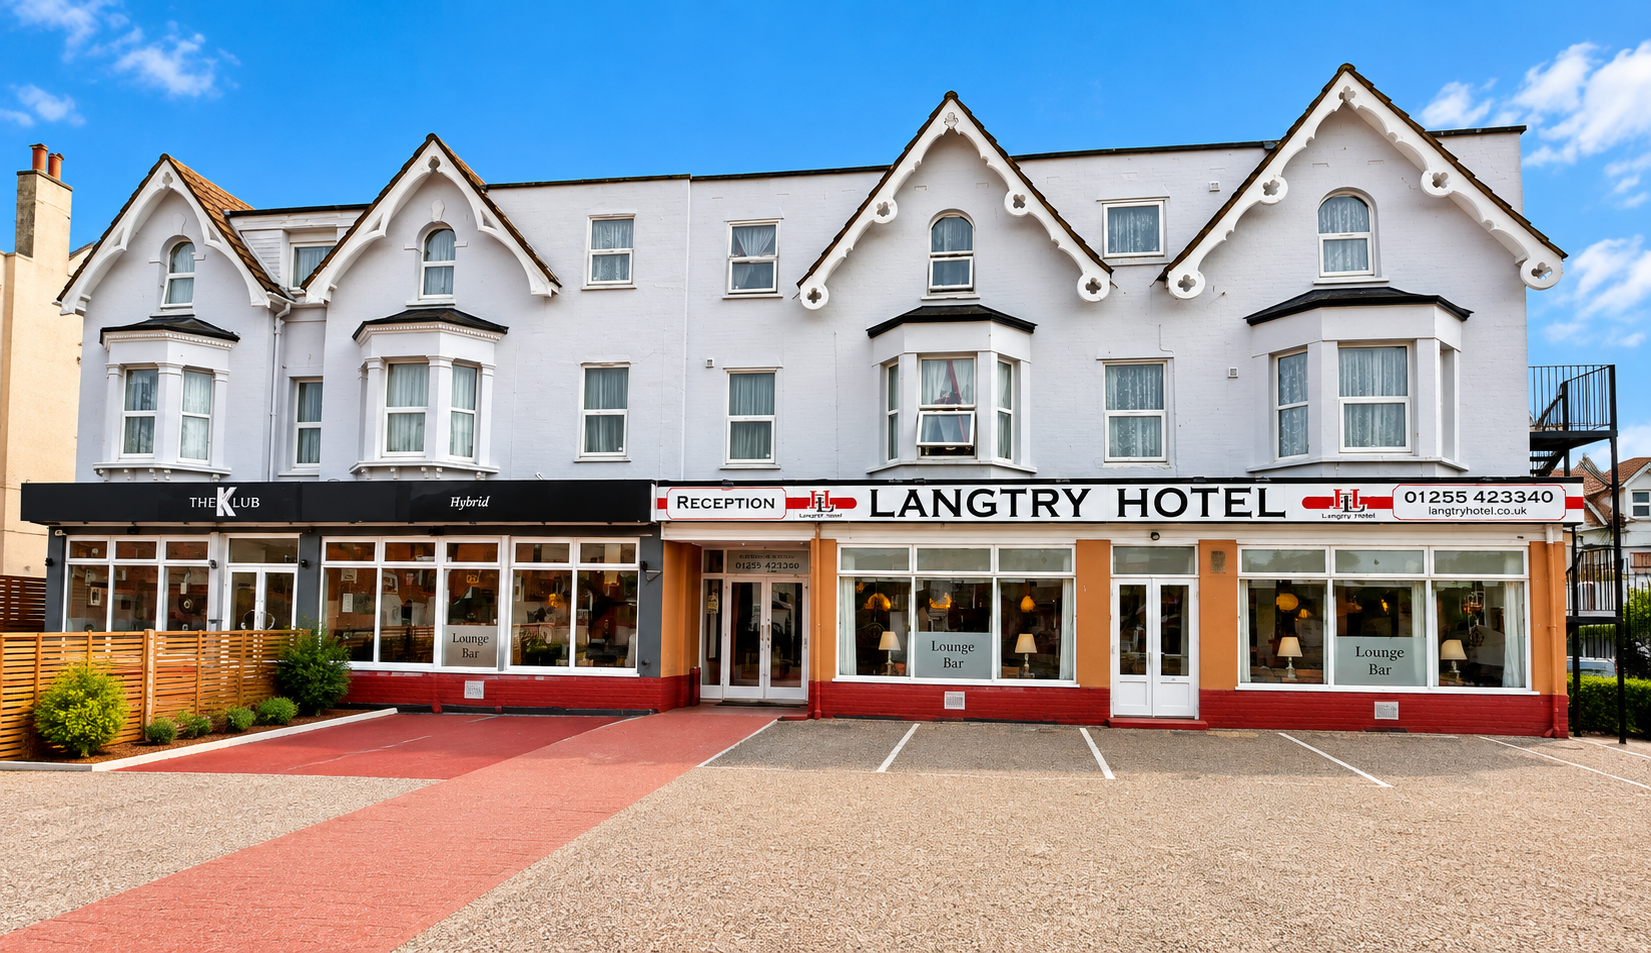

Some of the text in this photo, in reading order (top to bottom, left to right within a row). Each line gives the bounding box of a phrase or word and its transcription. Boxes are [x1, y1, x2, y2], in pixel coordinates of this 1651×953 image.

[189, 497, 216, 508] THE
[450, 495, 490, 510] Hybrid
[869, 486, 1286, 518] LANGTRY HOTEL
[1404, 490, 1554, 504] 01255 423340
[1428, 506, 1527, 517] langtryhotel.co.uk
[452, 633, 489, 646] Lounge
[462, 648, 480, 658] Bar
[931, 640, 975, 655] Lounge
[1355, 646, 1405, 661] Lounge
[943, 657, 964, 669] Bar
[1368, 663, 1392, 675] Bar
